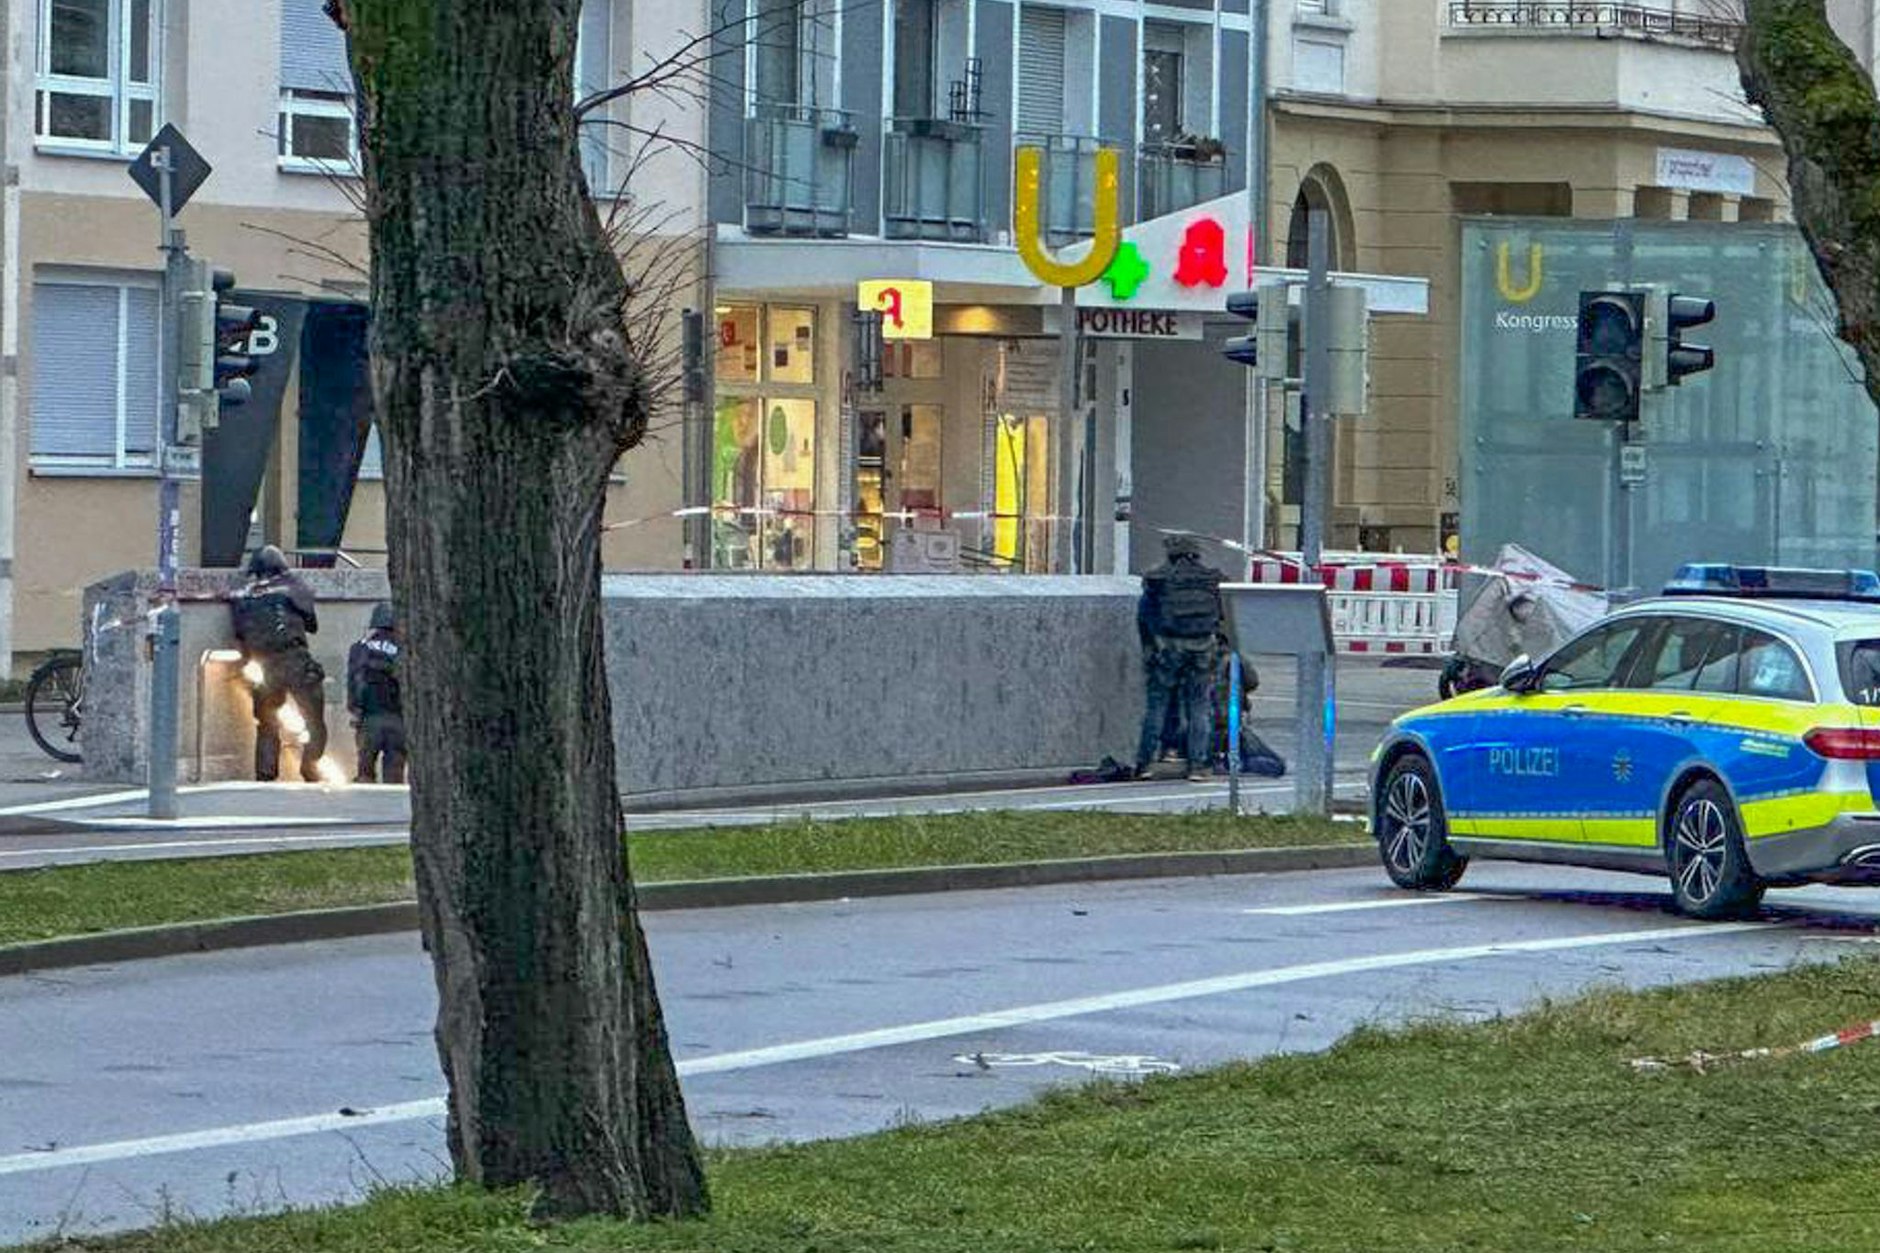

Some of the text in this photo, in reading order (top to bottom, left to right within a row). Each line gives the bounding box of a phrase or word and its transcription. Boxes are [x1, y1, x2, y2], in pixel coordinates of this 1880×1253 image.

[1016, 147, 1119, 287] U
[1498, 241, 1541, 300] U
[1077, 309, 1178, 336] POTHEKE
[1489, 747, 1560, 777] POLIZEI
